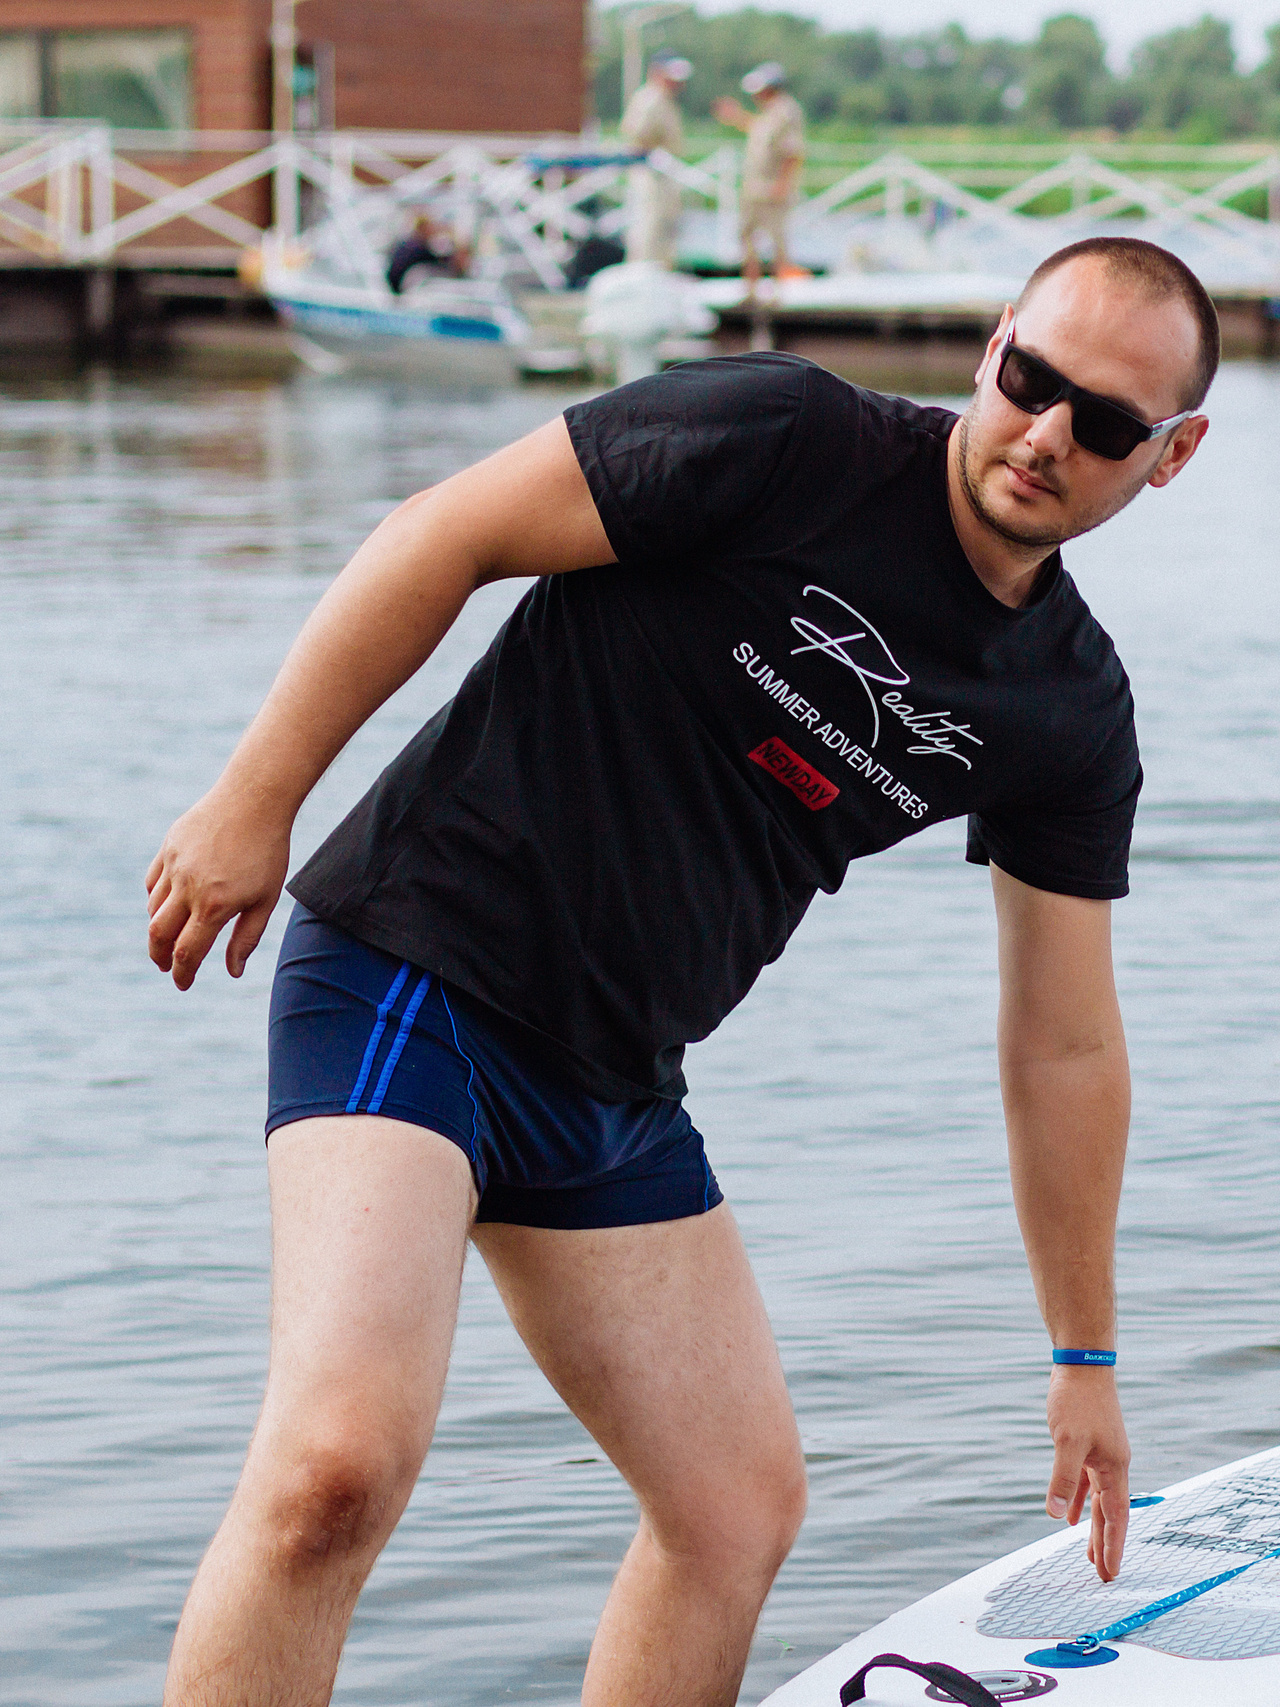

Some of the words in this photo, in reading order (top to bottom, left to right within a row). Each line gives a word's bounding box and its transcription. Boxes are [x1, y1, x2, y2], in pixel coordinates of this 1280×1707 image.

[732, 642, 821, 730] SUMMER
[812, 722, 929, 819] ADVENTURES
[790, 584, 984, 770] Reality
